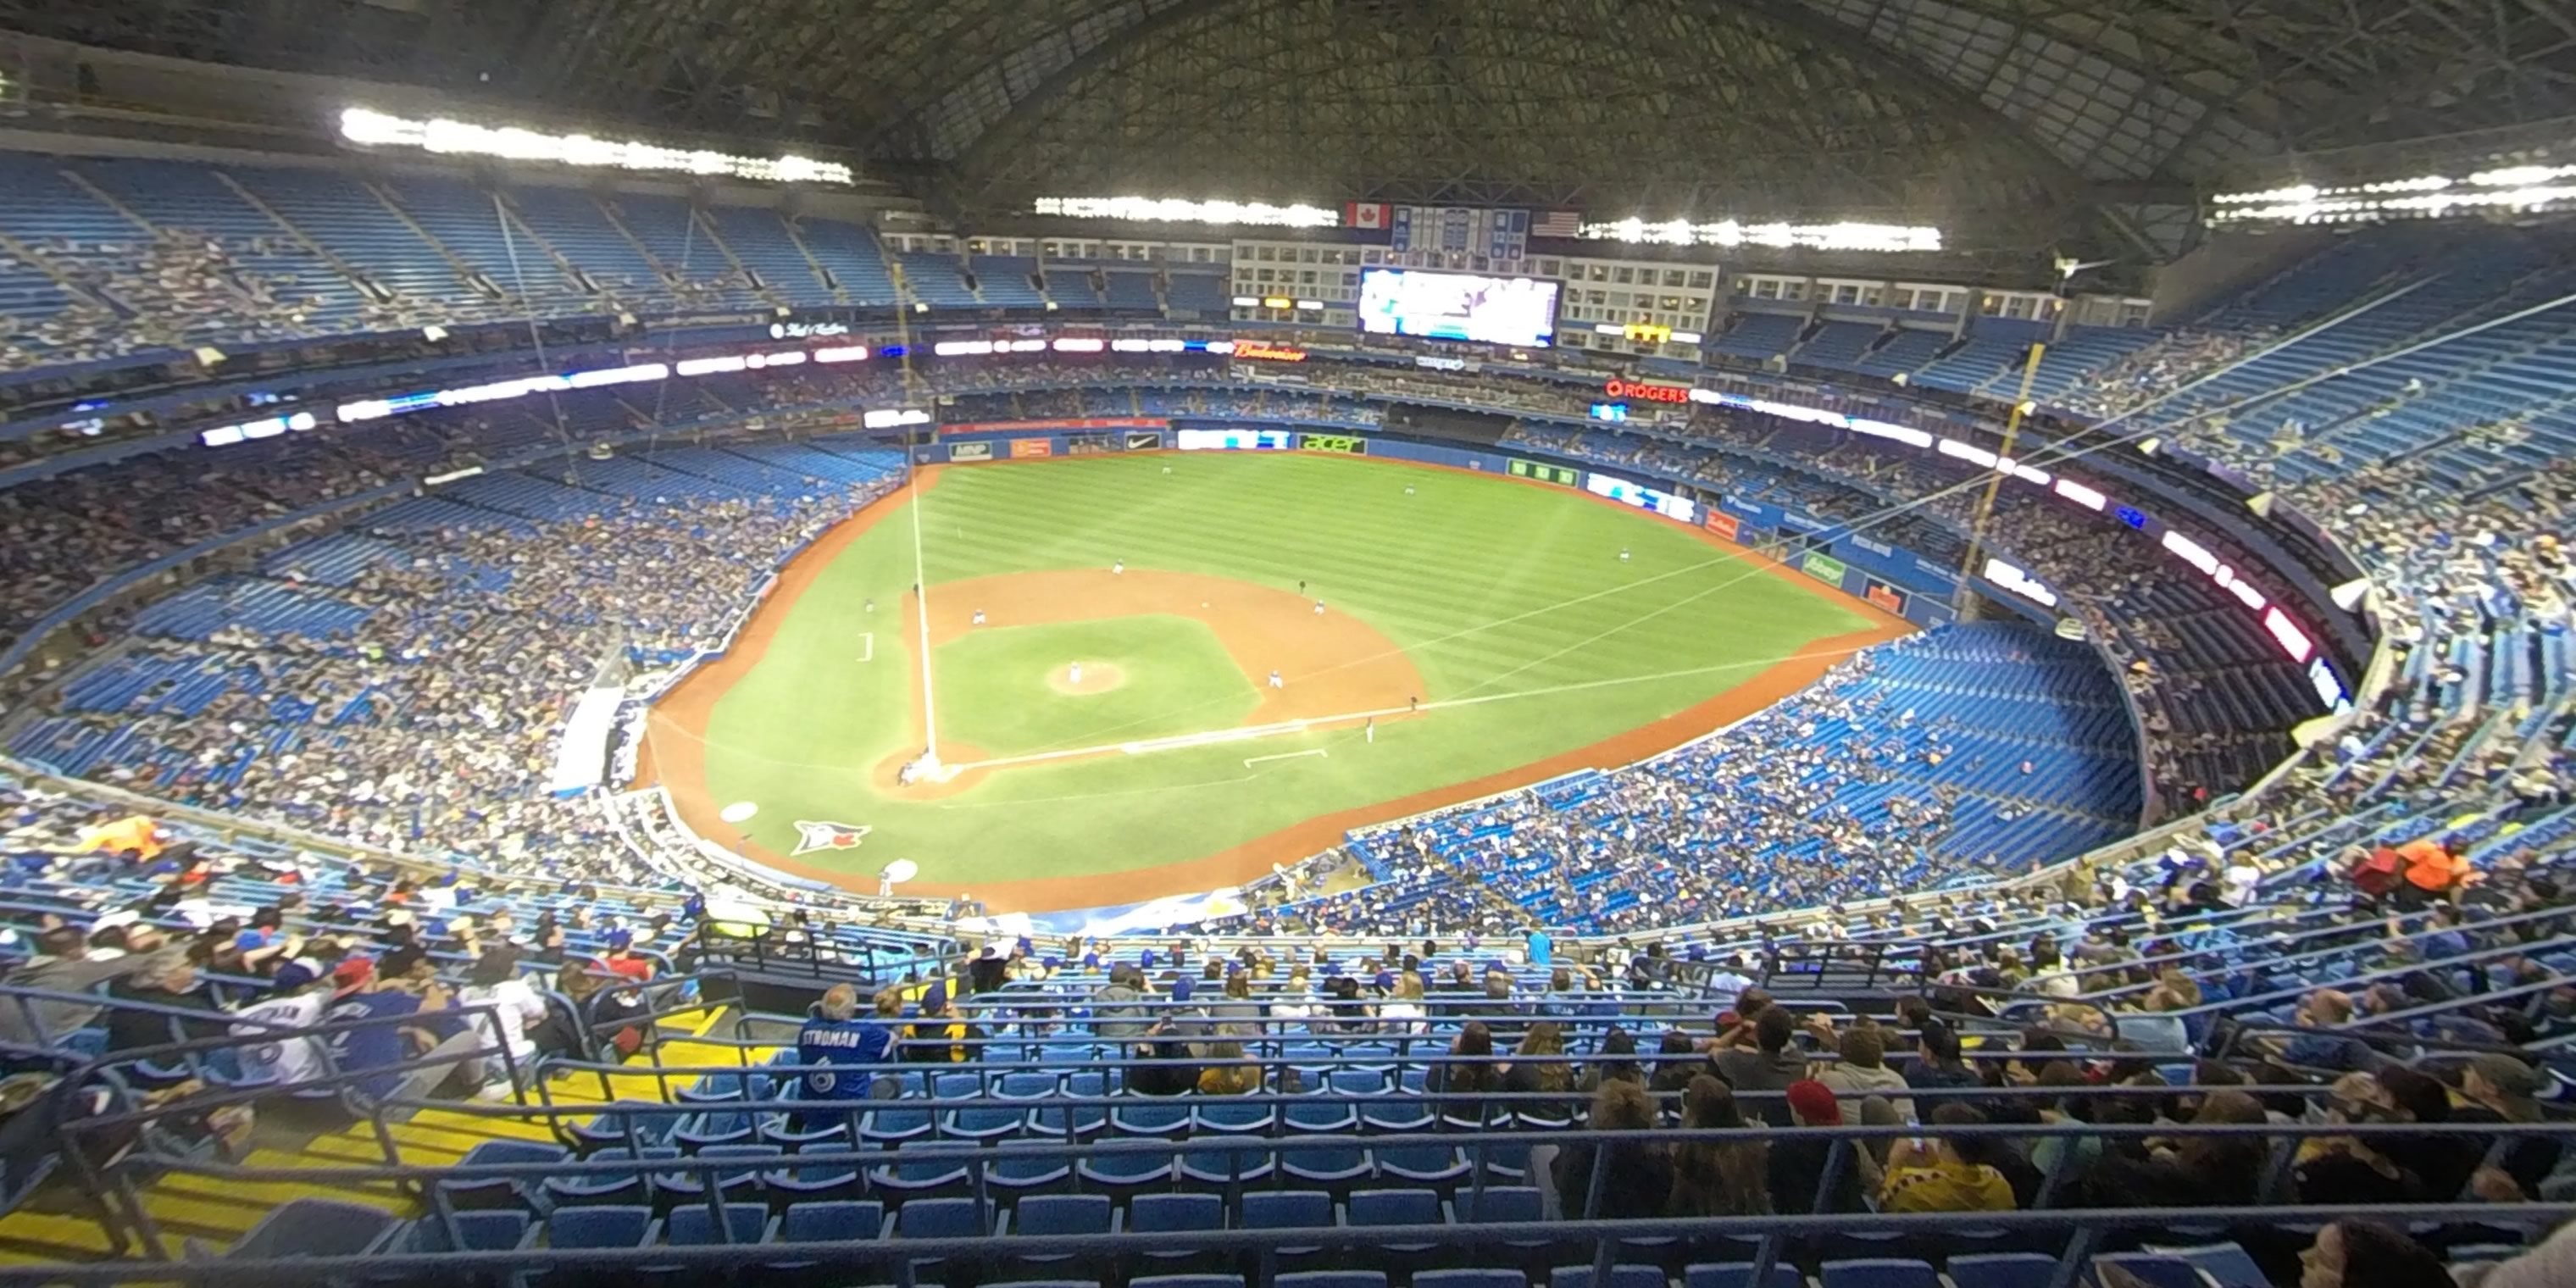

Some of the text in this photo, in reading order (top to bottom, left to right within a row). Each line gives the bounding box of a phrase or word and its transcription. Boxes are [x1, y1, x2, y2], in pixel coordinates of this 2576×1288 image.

[1624, 384, 1688, 402] ROGERS
[1303, 436, 1366, 453] acer
[802, 1030, 861, 1048] STROMAN
